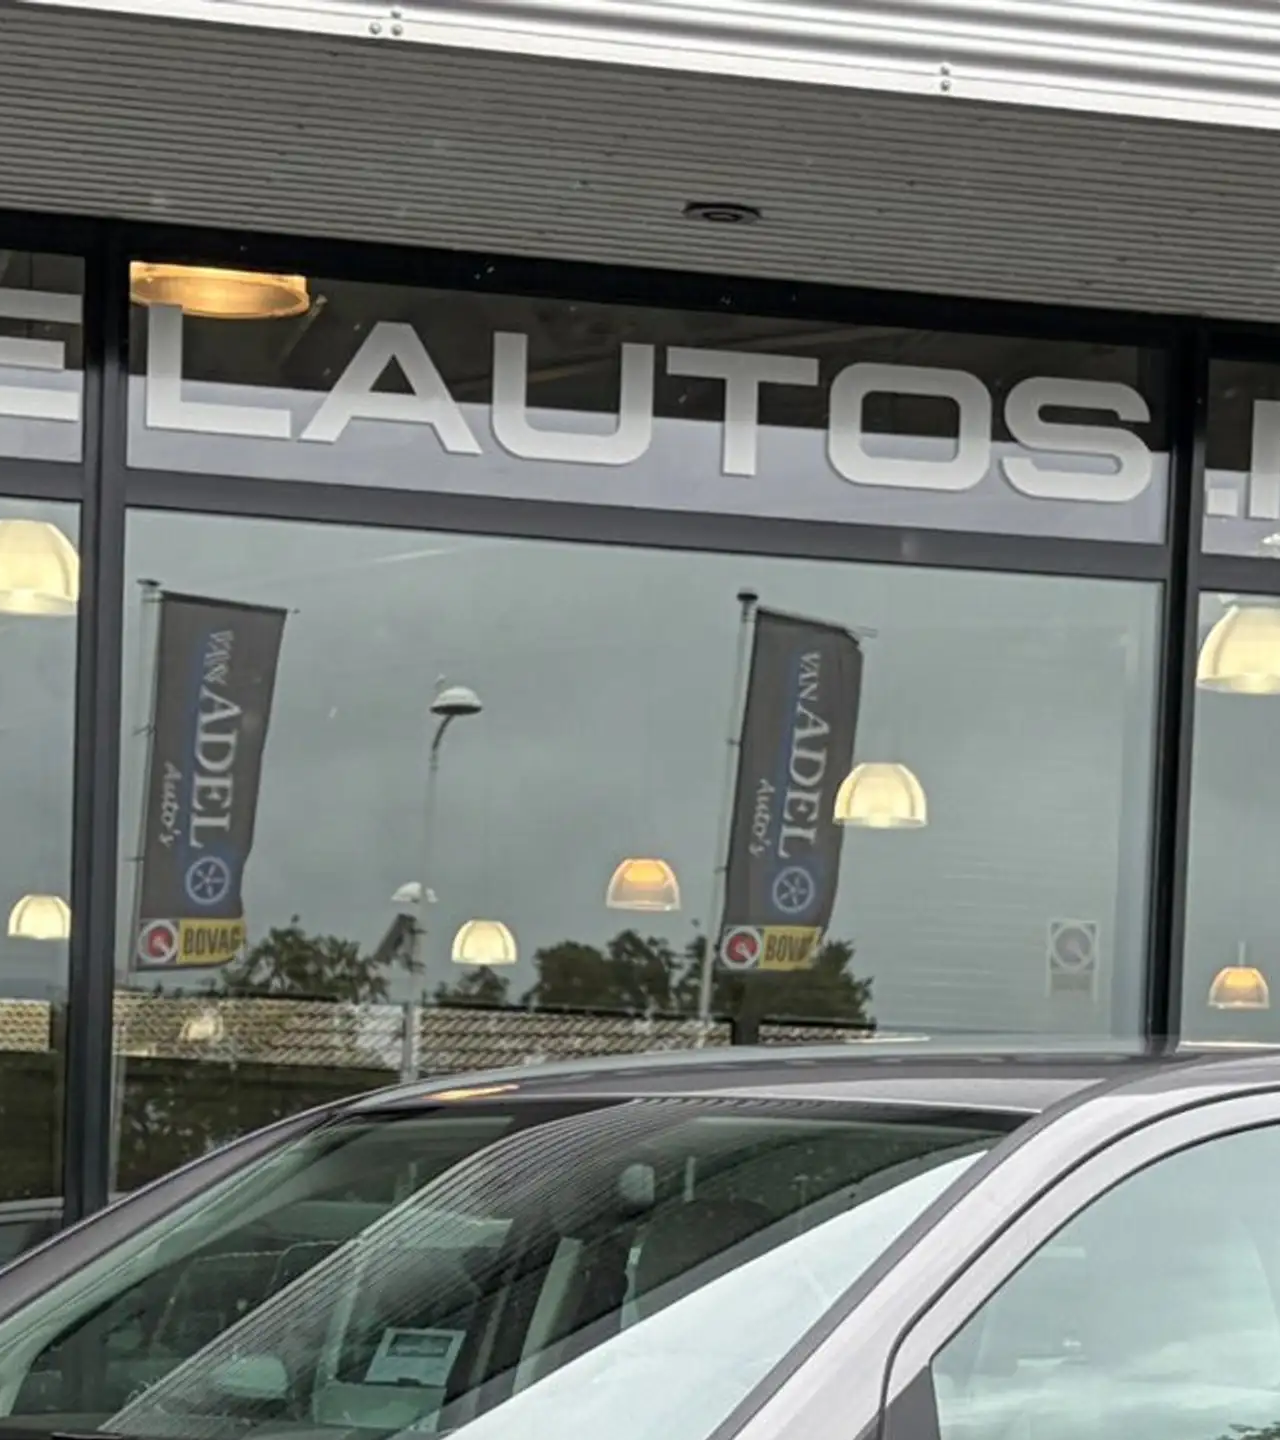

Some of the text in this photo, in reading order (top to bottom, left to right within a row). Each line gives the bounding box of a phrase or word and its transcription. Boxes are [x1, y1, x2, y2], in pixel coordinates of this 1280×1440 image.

[189, 684, 242, 850] ADEL
[778, 651, 831, 859] VAN ADEL
